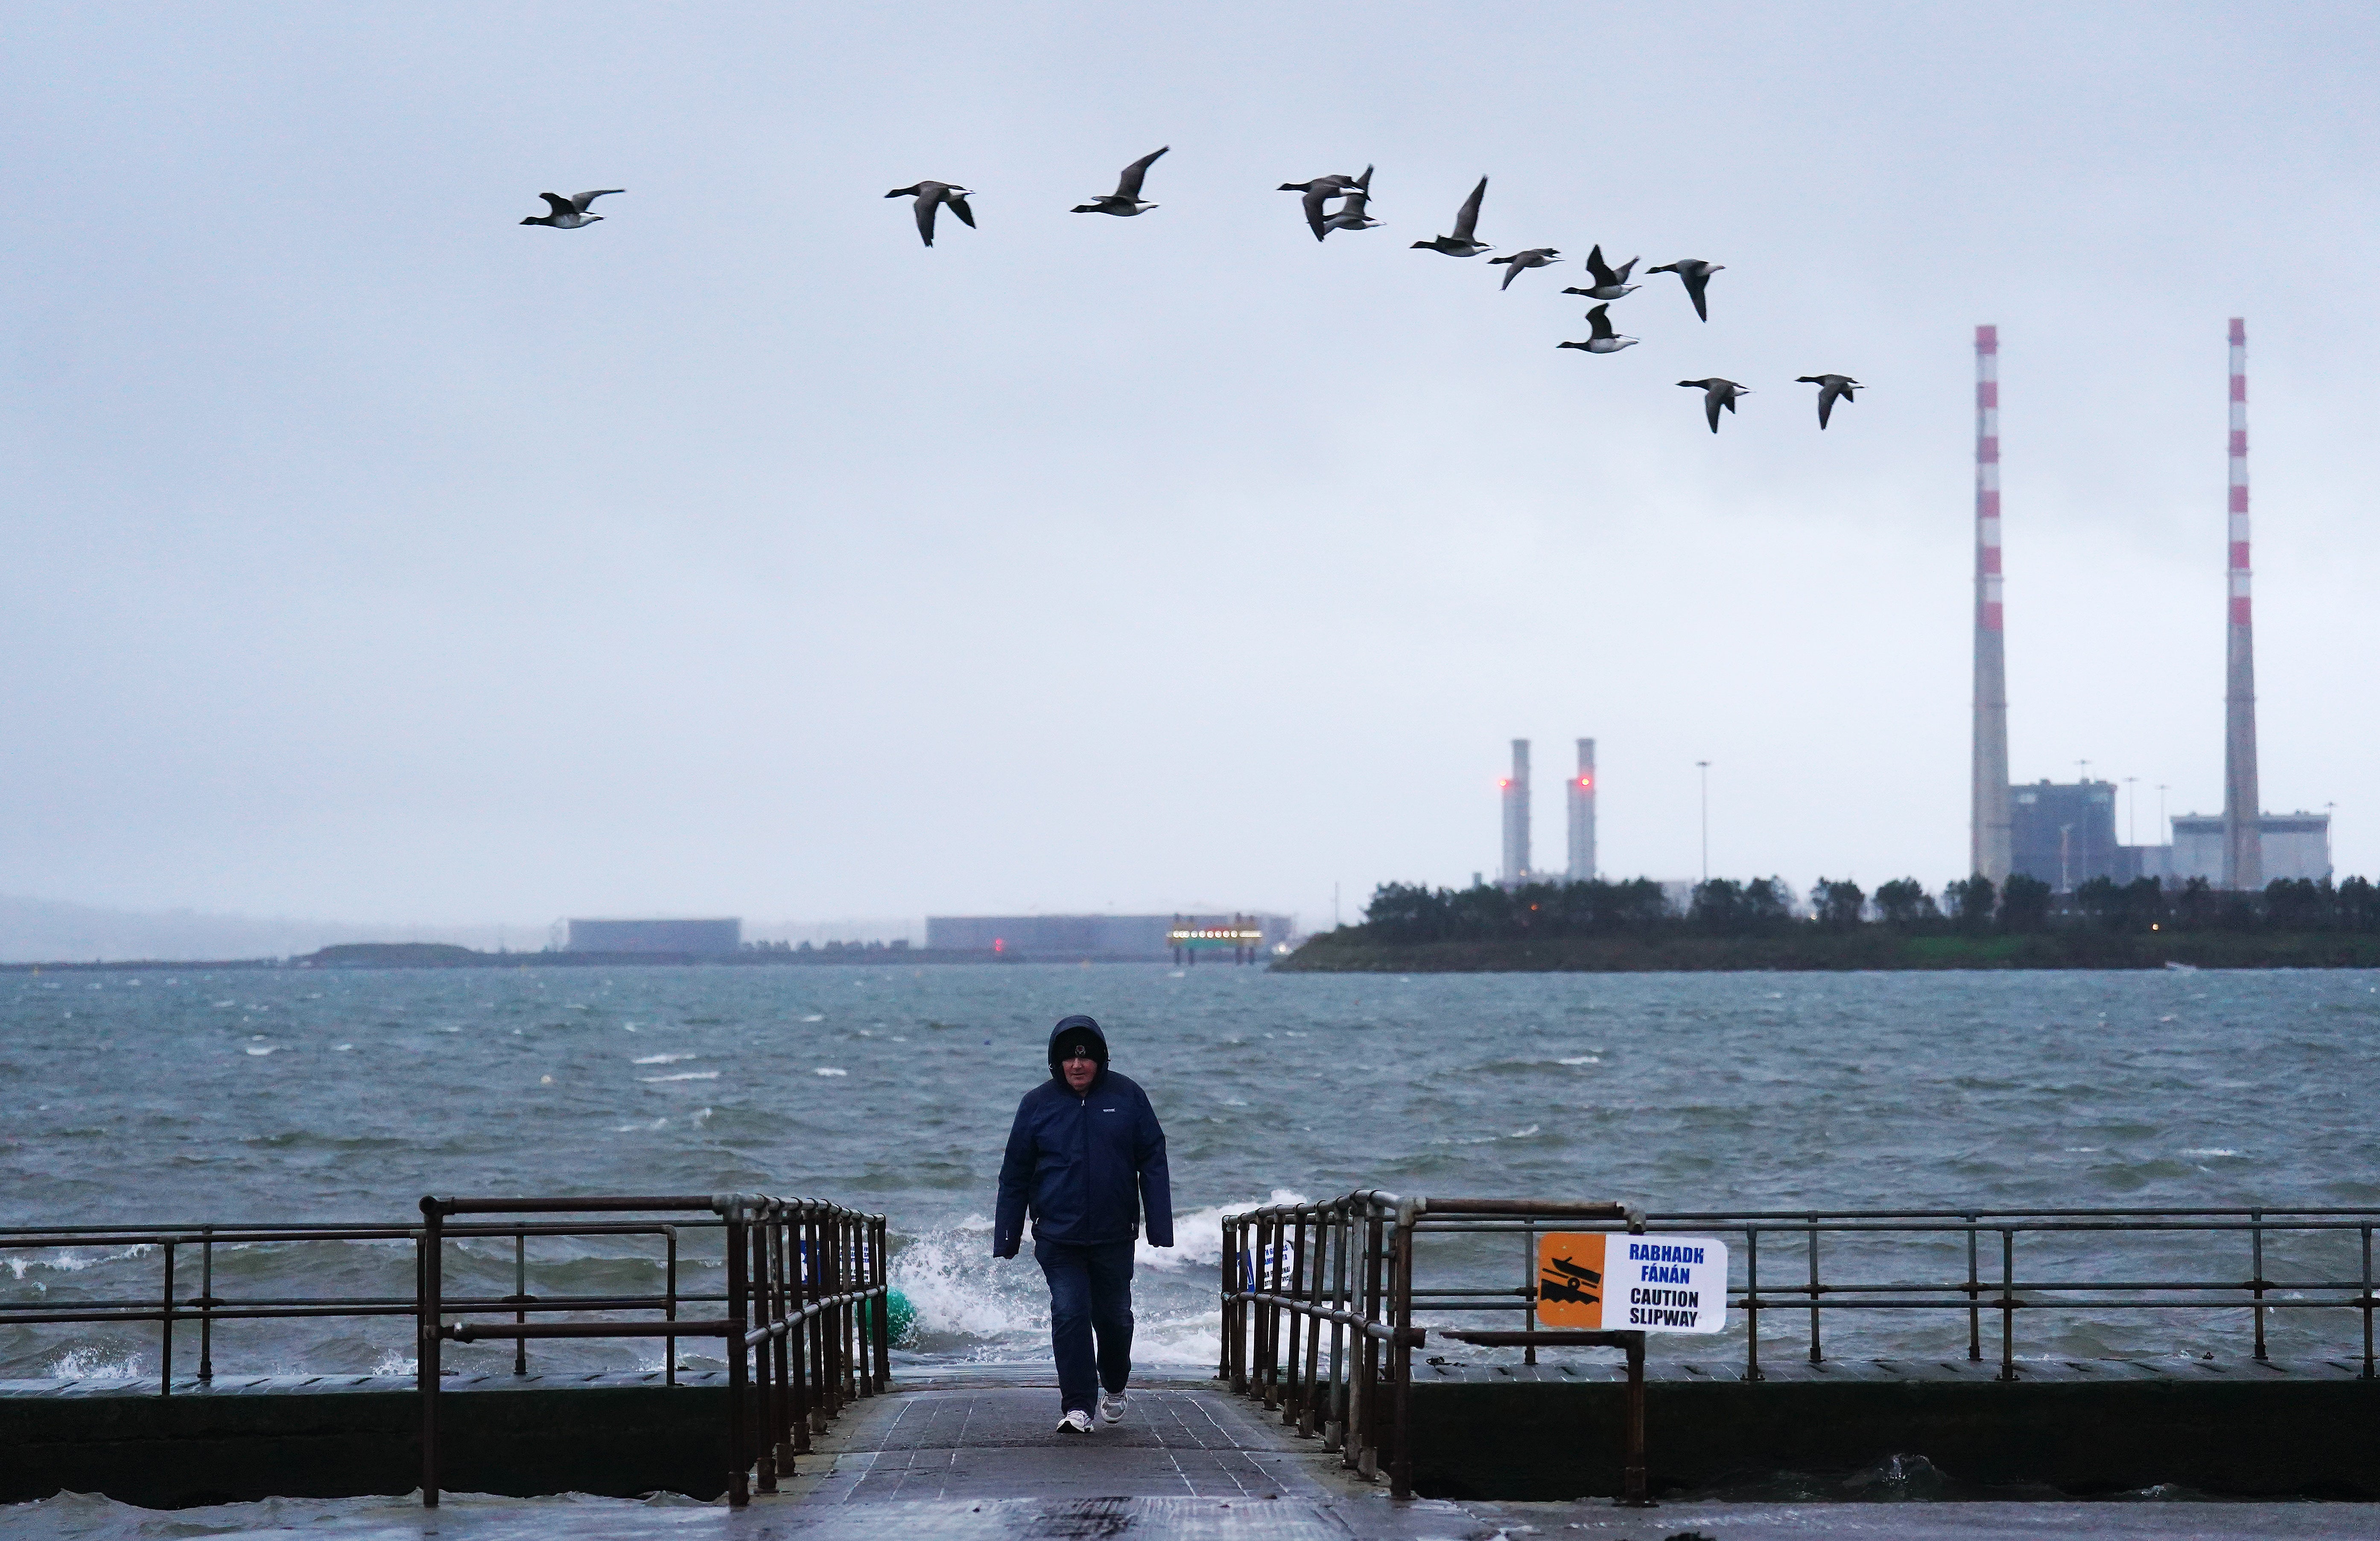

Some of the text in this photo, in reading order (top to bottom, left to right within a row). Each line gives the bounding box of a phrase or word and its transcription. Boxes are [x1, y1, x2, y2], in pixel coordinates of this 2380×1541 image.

[1629, 1243, 1704, 1264] RABHADH
[1641, 1263, 1690, 1284] FÁNÁN
[1630, 1288, 1699, 1308] CAUTION
[1629, 1308, 1698, 1328] SLIPWAY
